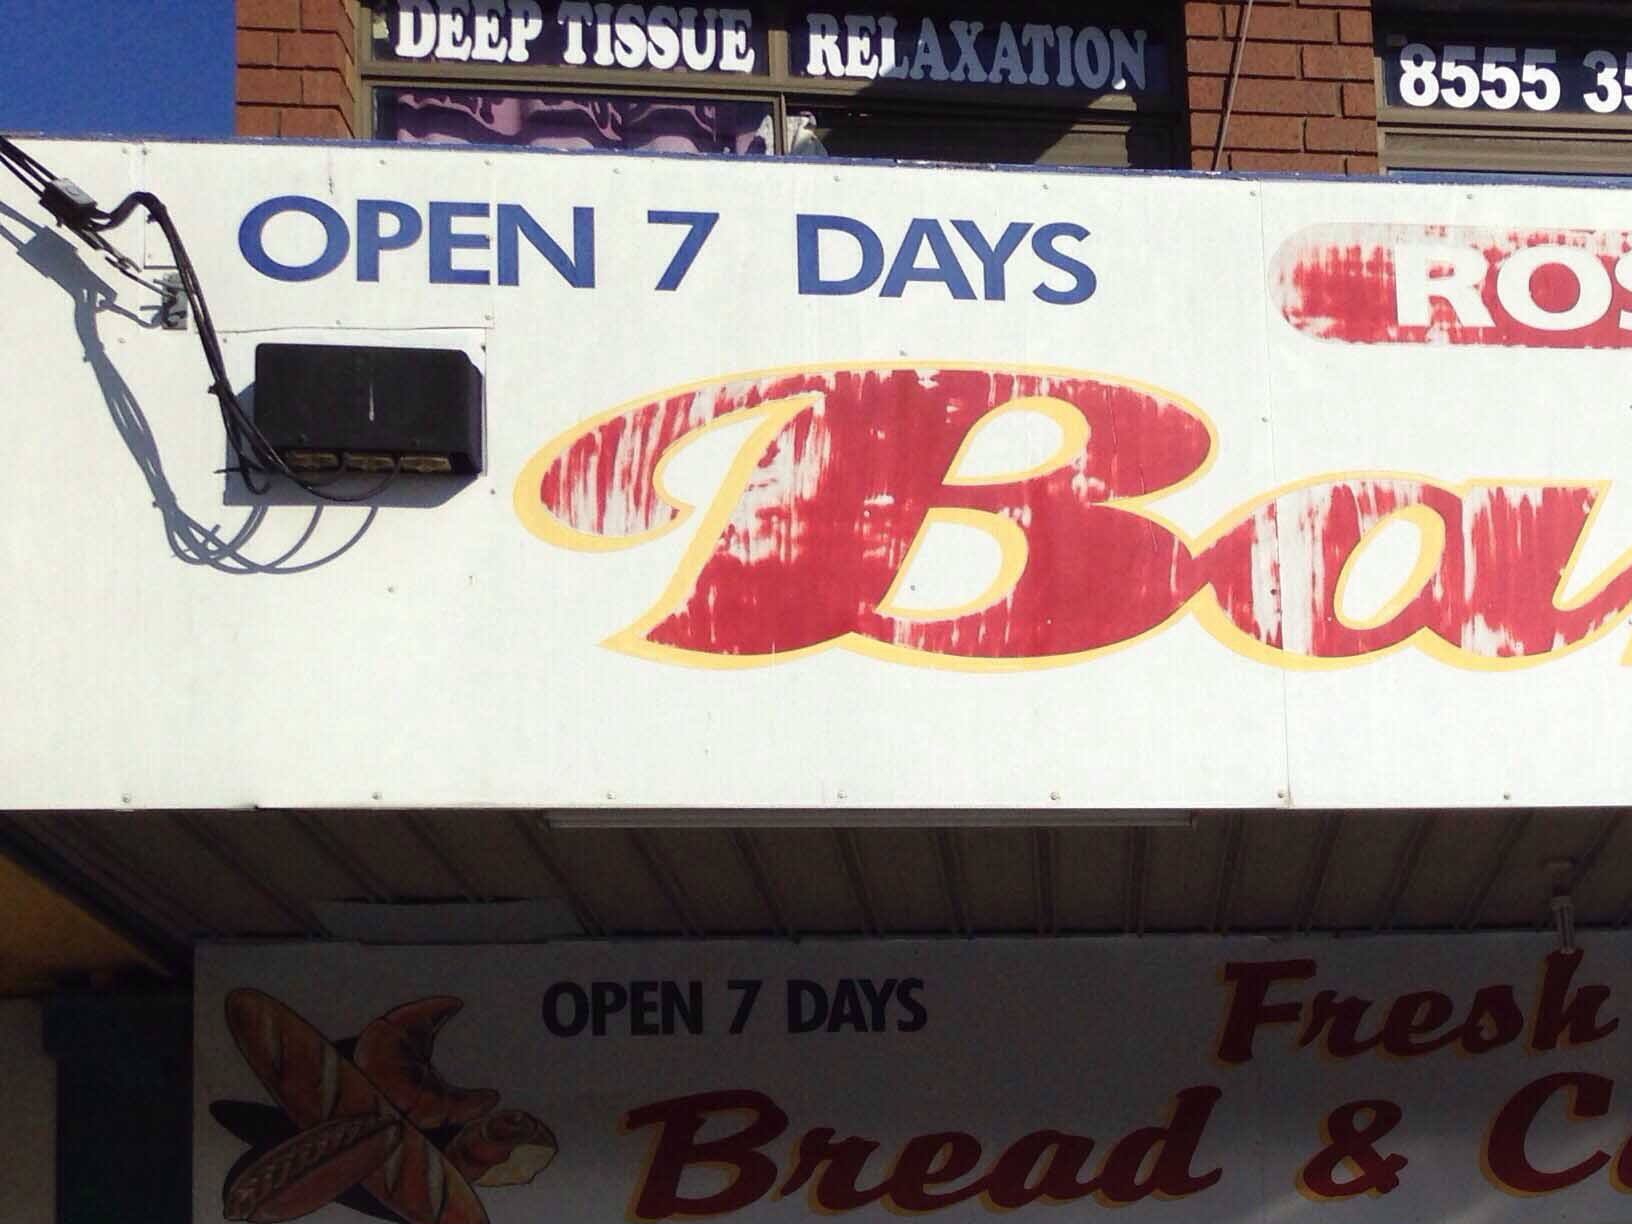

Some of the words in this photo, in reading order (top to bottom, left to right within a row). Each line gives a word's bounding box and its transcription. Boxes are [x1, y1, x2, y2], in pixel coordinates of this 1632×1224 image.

[395, 0, 543, 63] DEEP
[558, 1, 755, 73] TISSUE
[806, 12, 1147, 92] RELAXATION
[1399, 44, 1562, 110] 8555
[237, 193, 596, 290] OPEN
[645, 209, 721, 292] 7
[795, 212, 1098, 306] DAYS
[540, 978, 704, 1039] OPEN
[726, 977, 762, 1037] 7
[786, 976, 928, 1034] DAYS
[1214, 948, 1620, 1064] Fresh
[623, 1085, 1223, 1224] Bread
[1294, 1097, 1410, 1204] &
